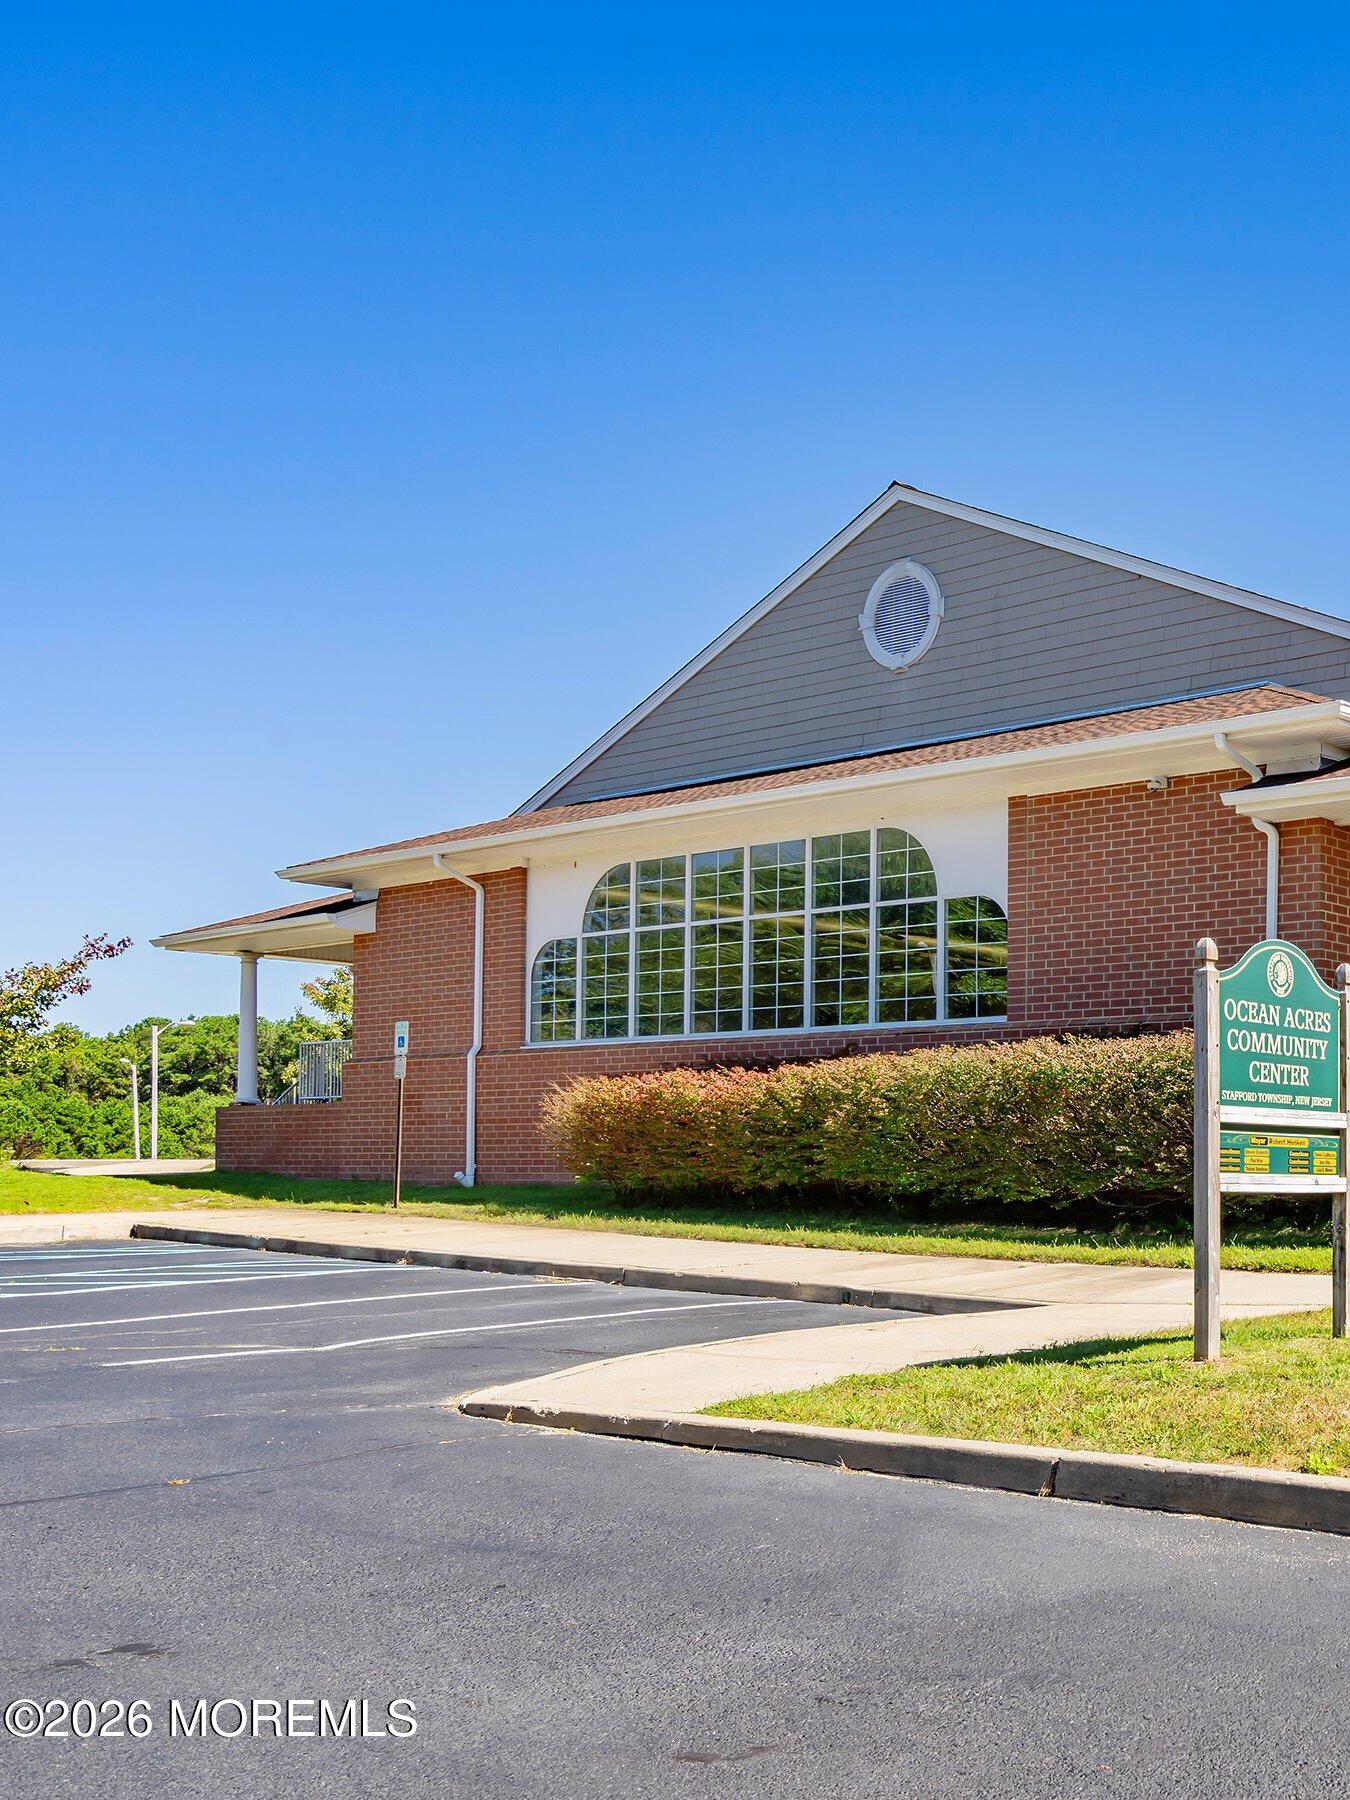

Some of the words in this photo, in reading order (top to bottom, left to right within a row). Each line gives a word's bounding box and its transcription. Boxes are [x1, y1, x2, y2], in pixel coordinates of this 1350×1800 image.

[1224, 998, 1280, 1027] OCEAN
[1284, 1007, 1332, 1034] ACRES
[1227, 1029, 1328, 1060] COMMUNITY
[1249, 1061, 1310, 1087] CENTER
[1221, 1090, 1257, 1102] STAFFORD
[1258, 1092, 1294, 1106] TOWNSHIP,
[1295, 1095, 1310, 1105] NEW
[1311, 1097, 1333, 1108] JERSEY
